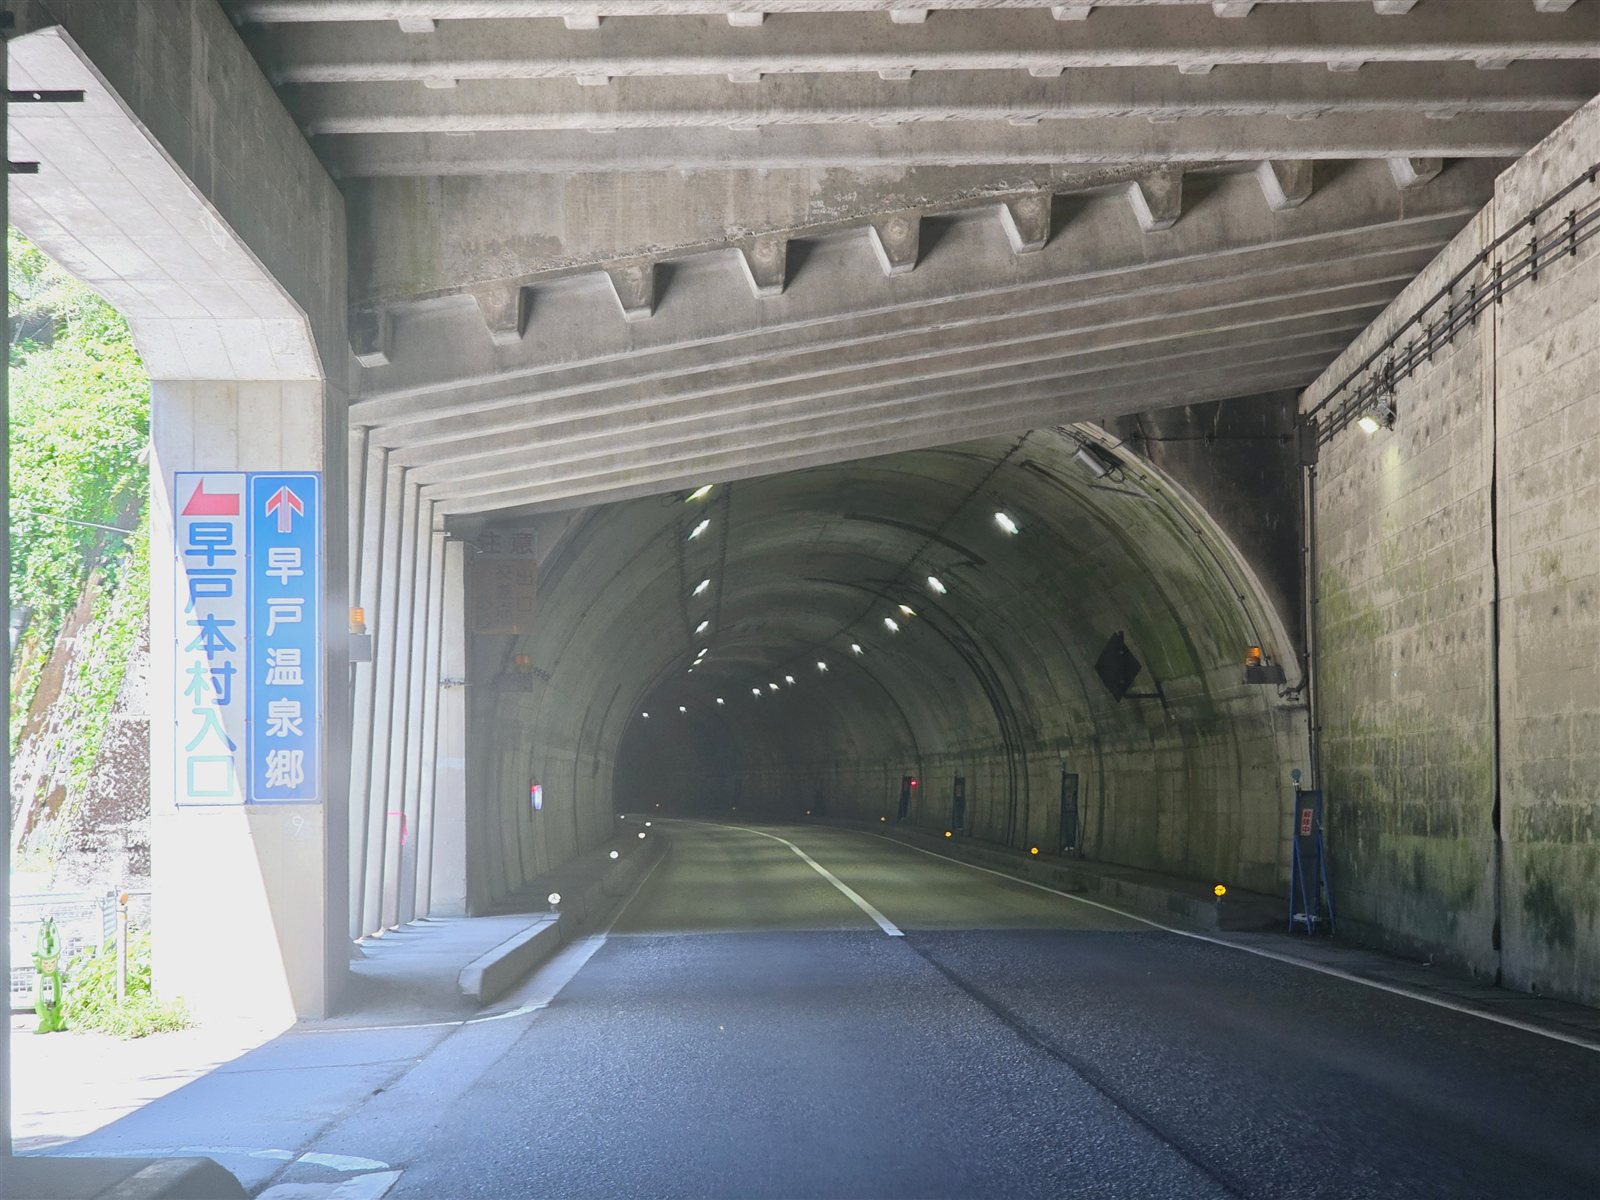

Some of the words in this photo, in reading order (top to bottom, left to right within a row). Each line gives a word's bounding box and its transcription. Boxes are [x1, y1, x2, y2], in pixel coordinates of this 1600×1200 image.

[184, 522, 237, 797] 早戸本村入口
[265, 547, 304, 789] 早戸温泉郷
